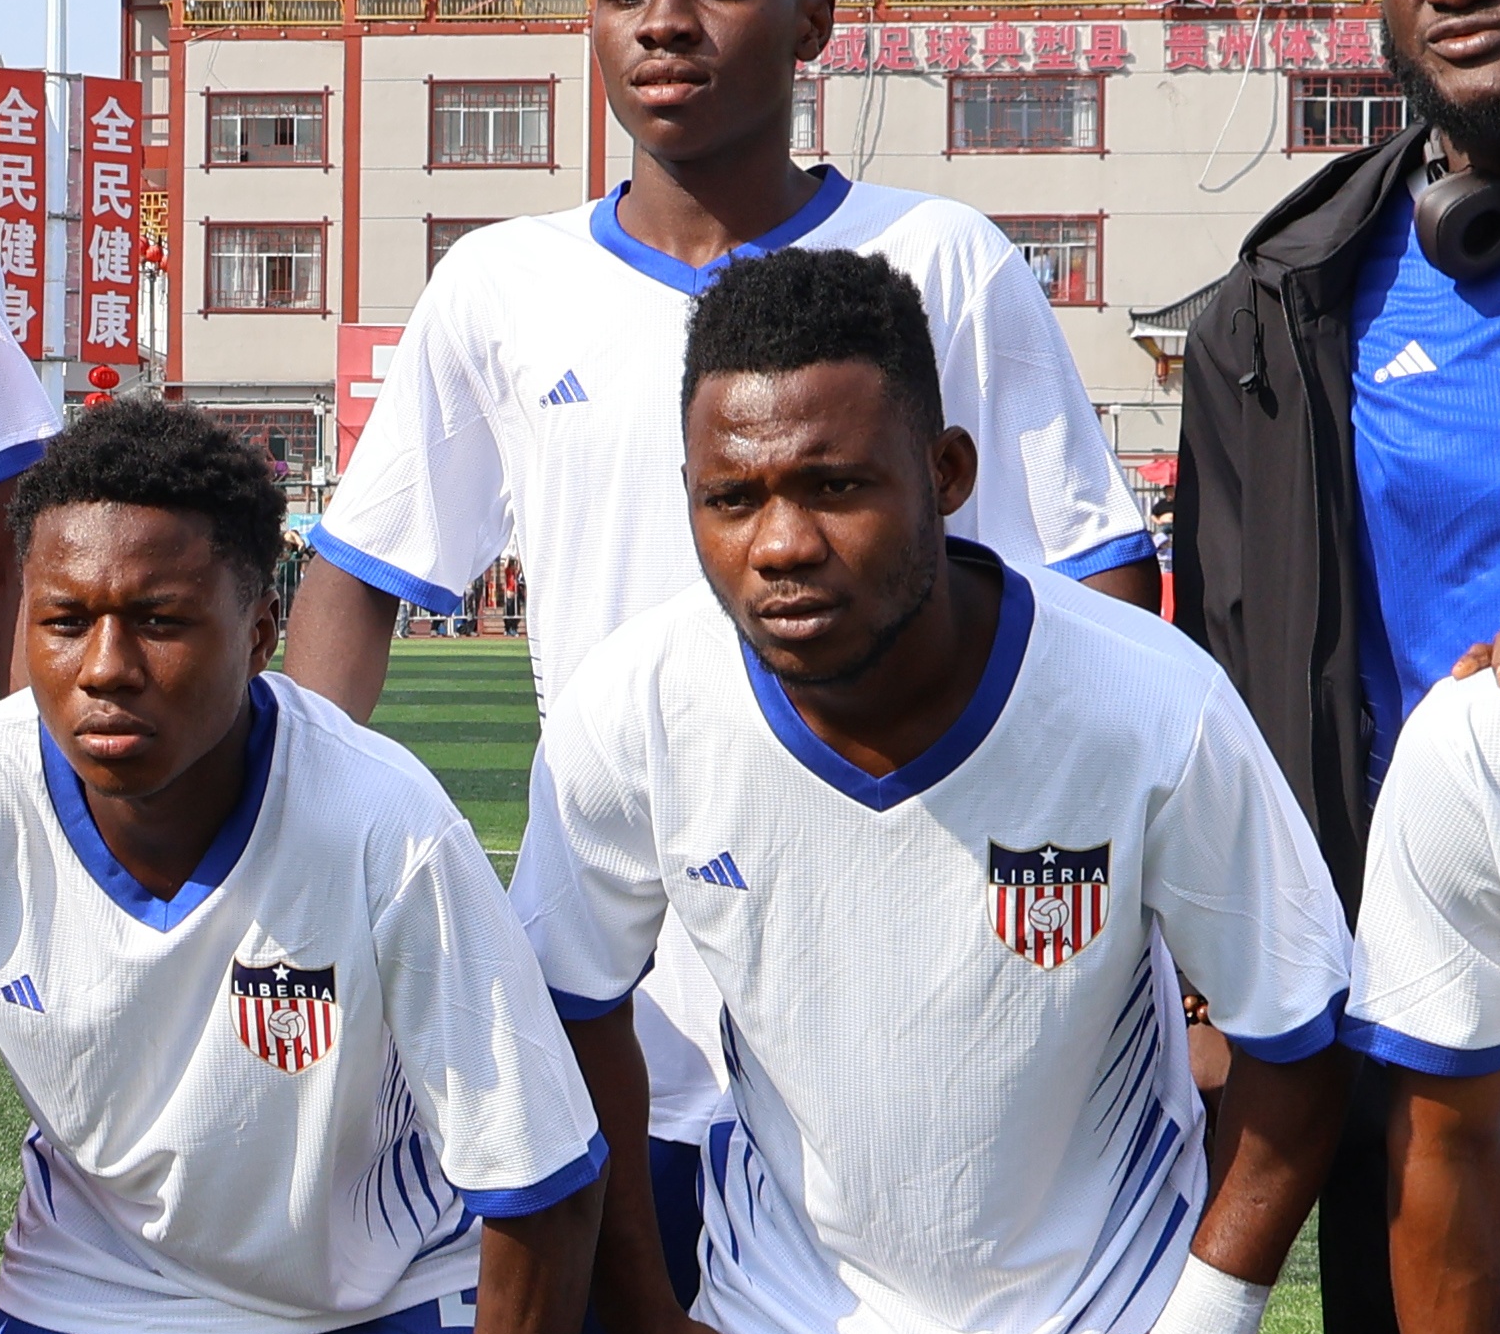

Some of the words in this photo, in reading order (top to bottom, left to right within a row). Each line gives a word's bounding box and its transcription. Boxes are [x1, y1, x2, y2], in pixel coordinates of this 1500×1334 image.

[797, 23, 1130, 71] 域足球典型县
[1164, 21, 1386, 67] 贵州体操
[87, 96, 135, 349] 全民健康
[994, 867, 1105, 885] LIBERIA
[233, 979, 333, 1002] LIBERIA
